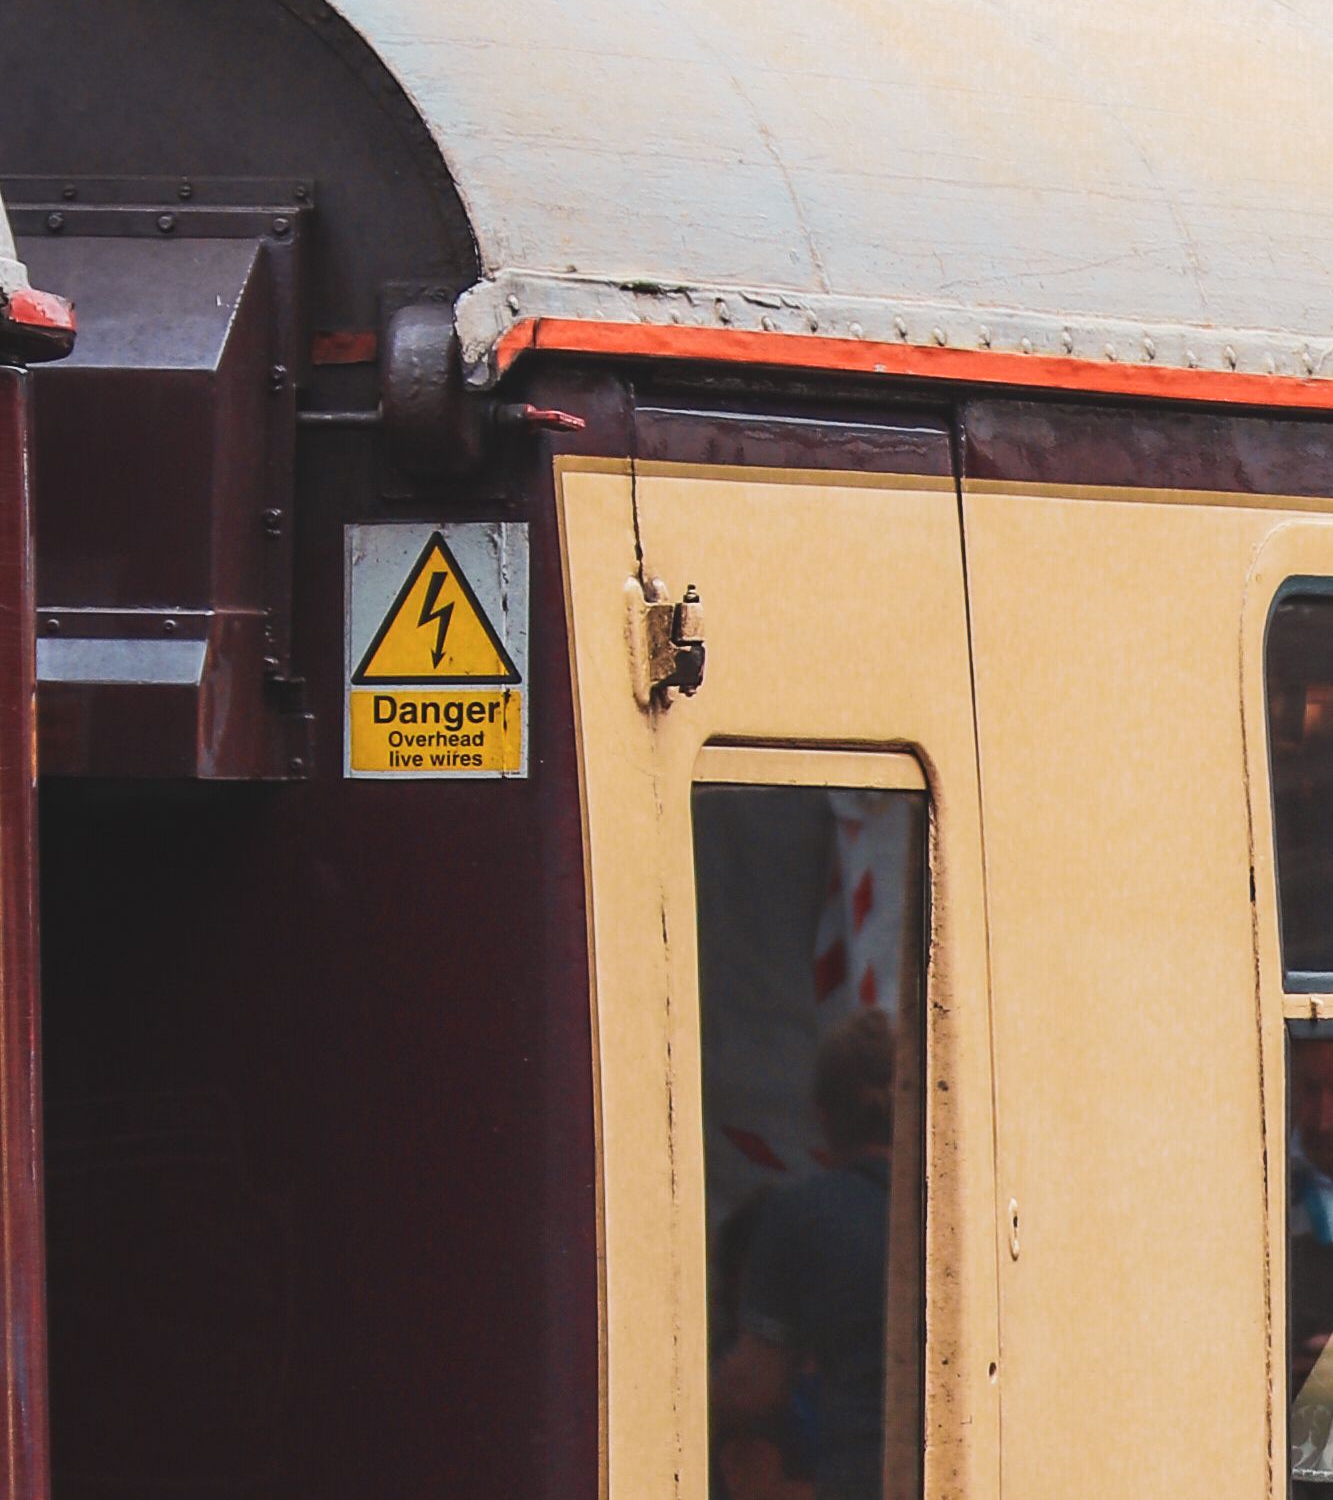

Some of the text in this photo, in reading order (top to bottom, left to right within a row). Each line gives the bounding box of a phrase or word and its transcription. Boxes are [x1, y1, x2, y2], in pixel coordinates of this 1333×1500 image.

[373, 694, 500, 731] Danger
[388, 730, 484, 748] Overhead
[389, 750, 483, 767] live wires
